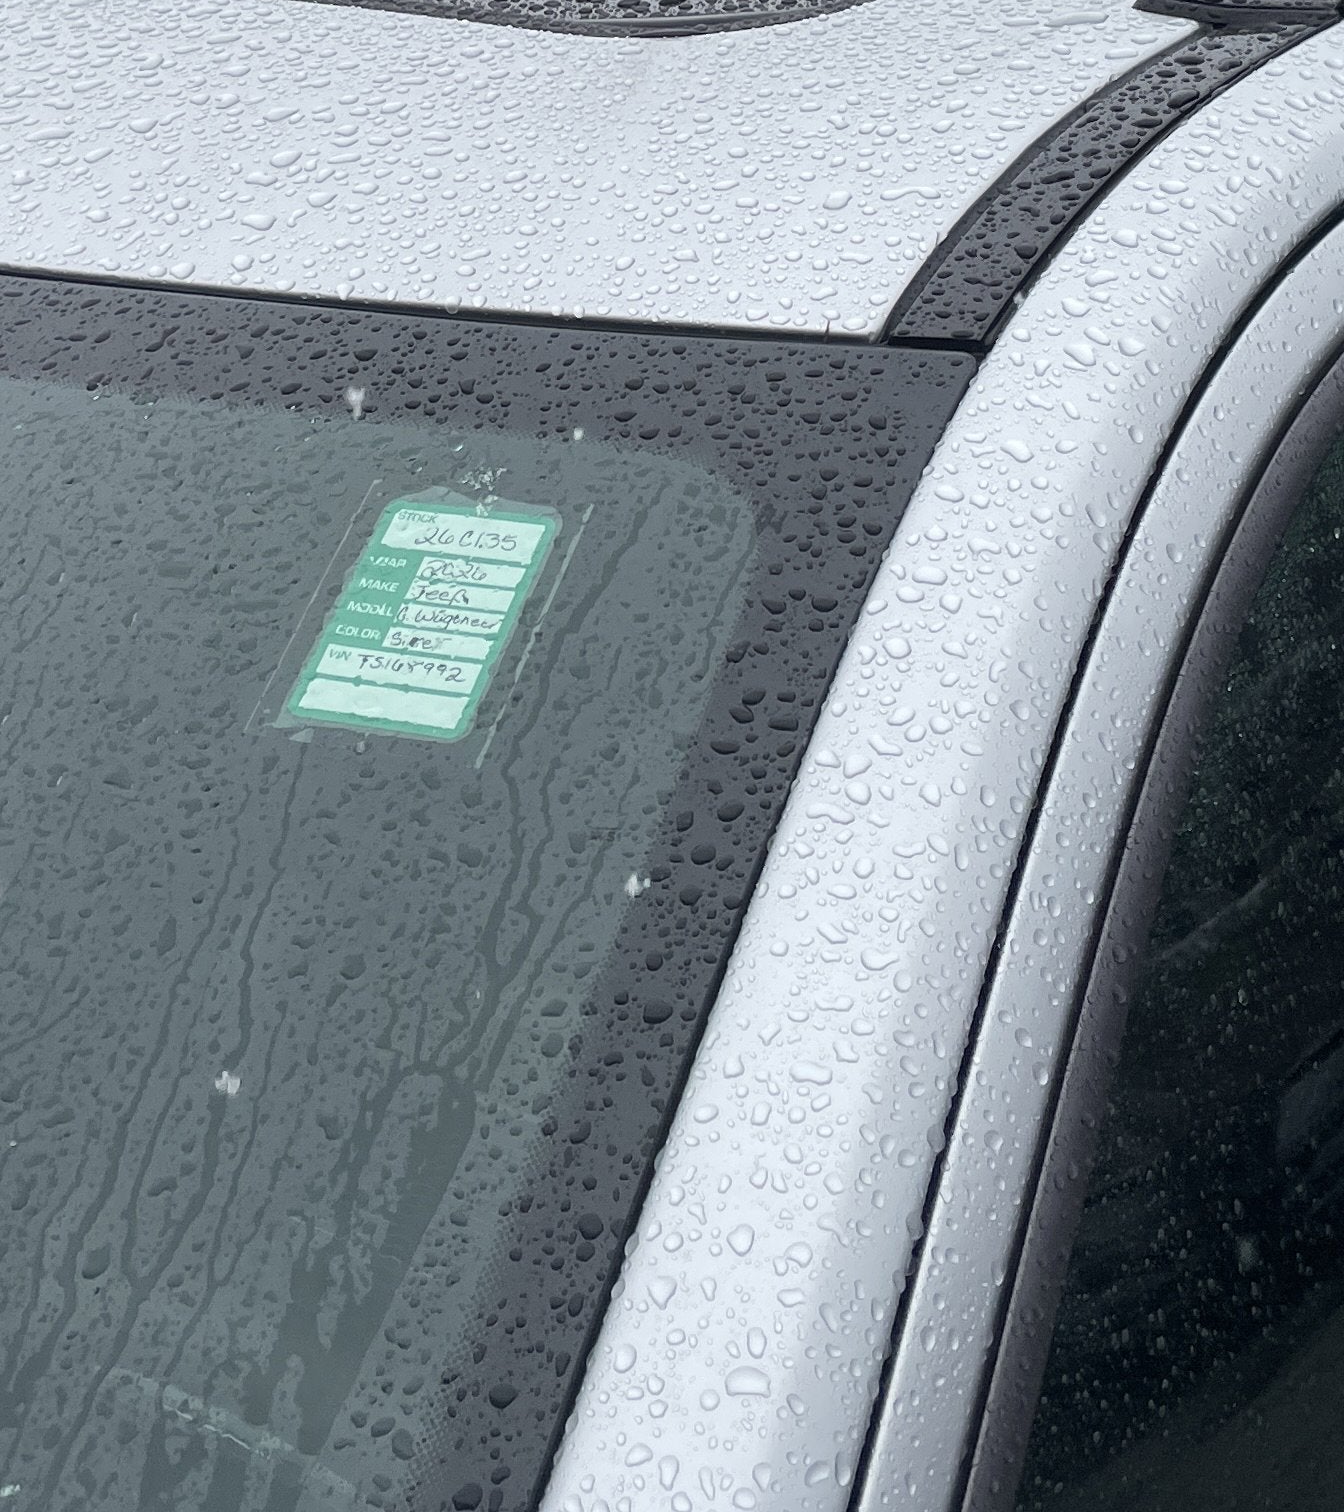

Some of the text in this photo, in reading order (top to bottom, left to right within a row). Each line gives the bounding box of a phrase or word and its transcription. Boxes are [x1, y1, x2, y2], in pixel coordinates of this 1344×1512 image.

[359, 578, 400, 592] MAKE
[335, 624, 382, 640] COLOR
[329, 648, 352, 661] VIN
